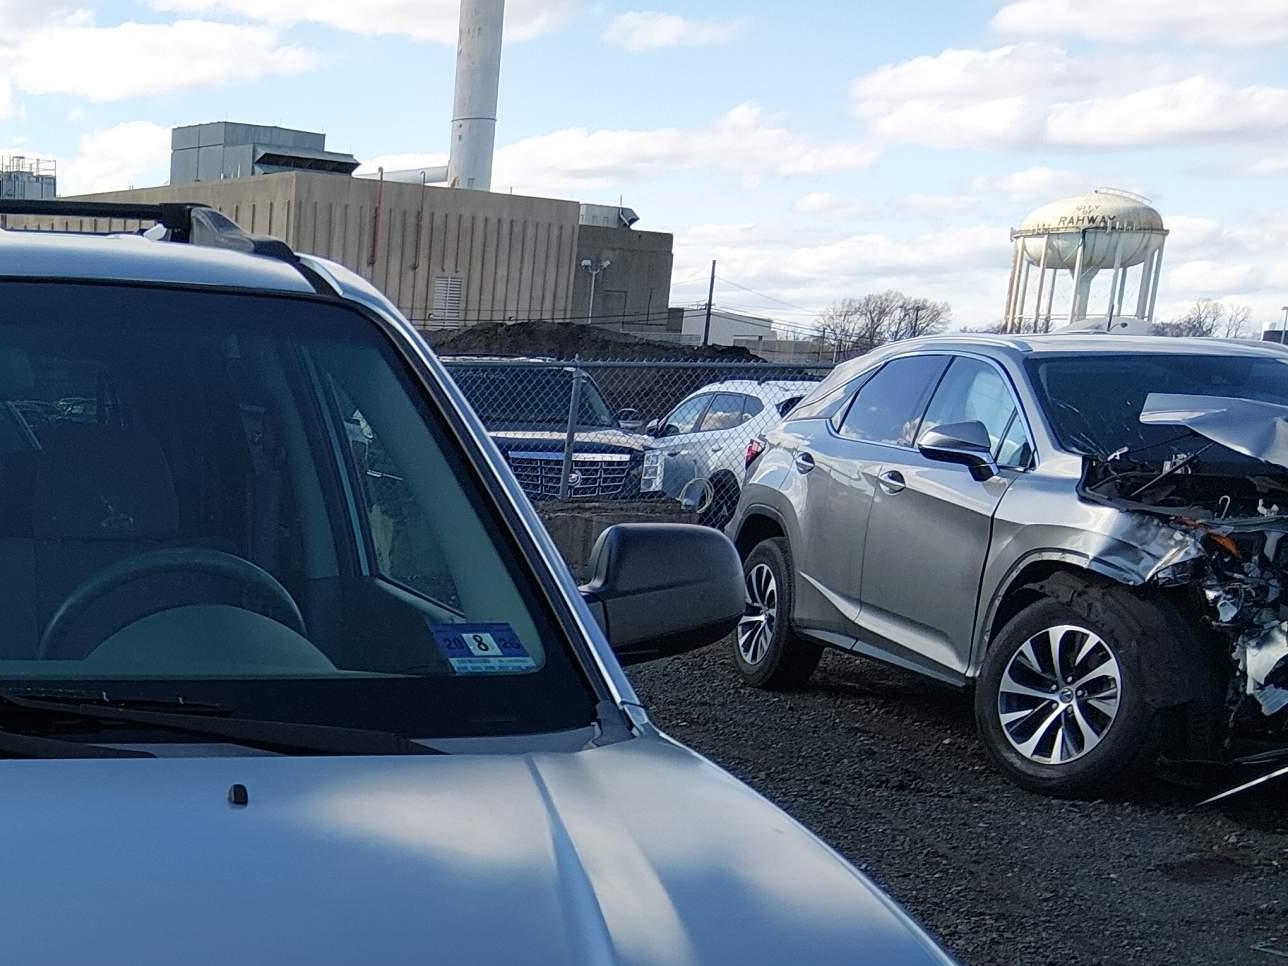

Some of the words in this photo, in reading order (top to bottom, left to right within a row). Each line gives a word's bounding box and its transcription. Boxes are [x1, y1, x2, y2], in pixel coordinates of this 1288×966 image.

[1058, 215, 1116, 226] RAHWAY
[443, 637, 465, 650] 20
[472, 634, 489, 652] 8
